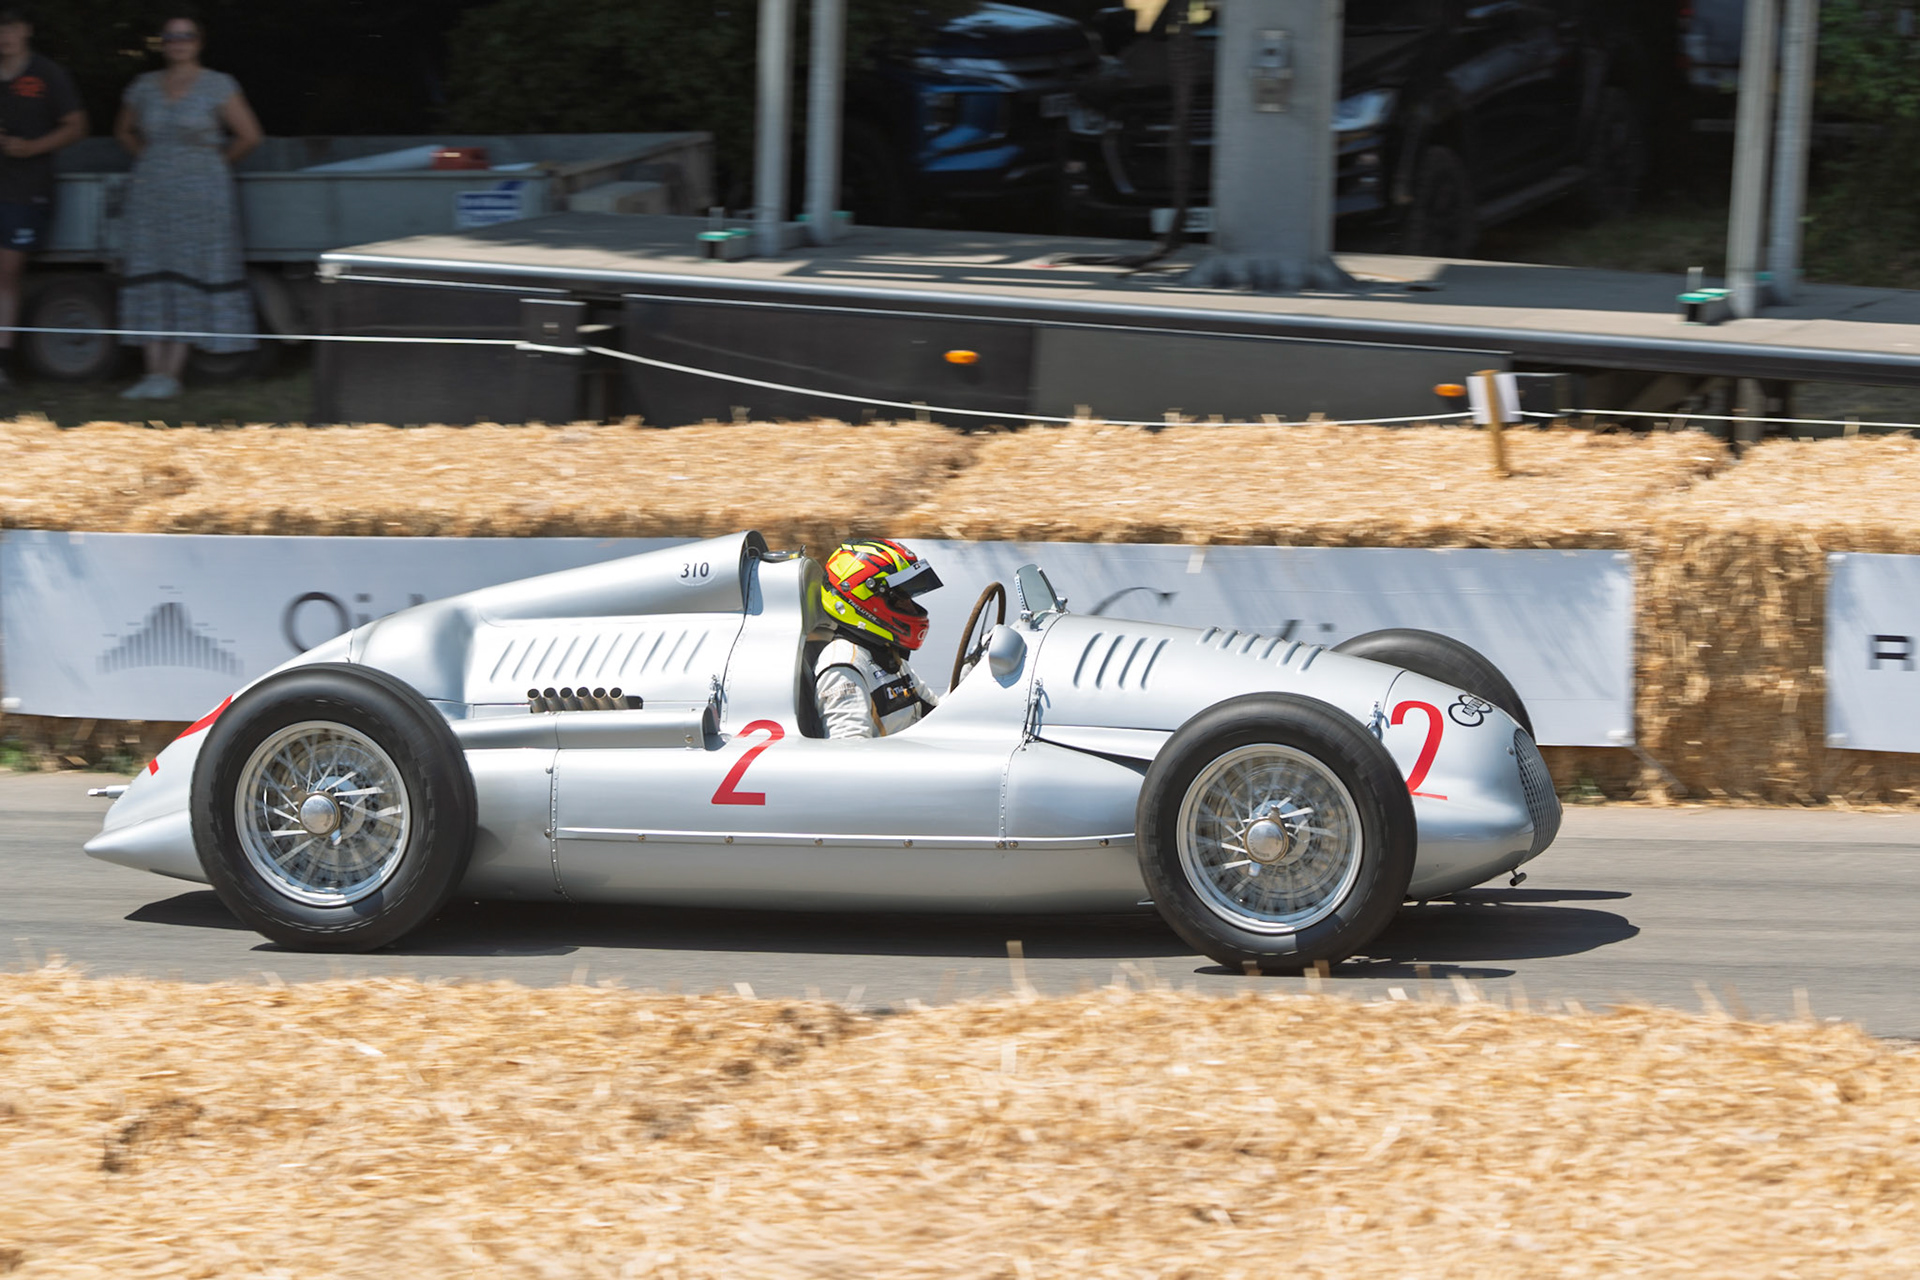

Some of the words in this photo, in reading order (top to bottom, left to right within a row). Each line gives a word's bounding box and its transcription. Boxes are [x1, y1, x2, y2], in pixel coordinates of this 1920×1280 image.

[680, 561, 710, 578] 310
[710, 719, 785, 806] 2
[1390, 700, 1448, 801] 2
